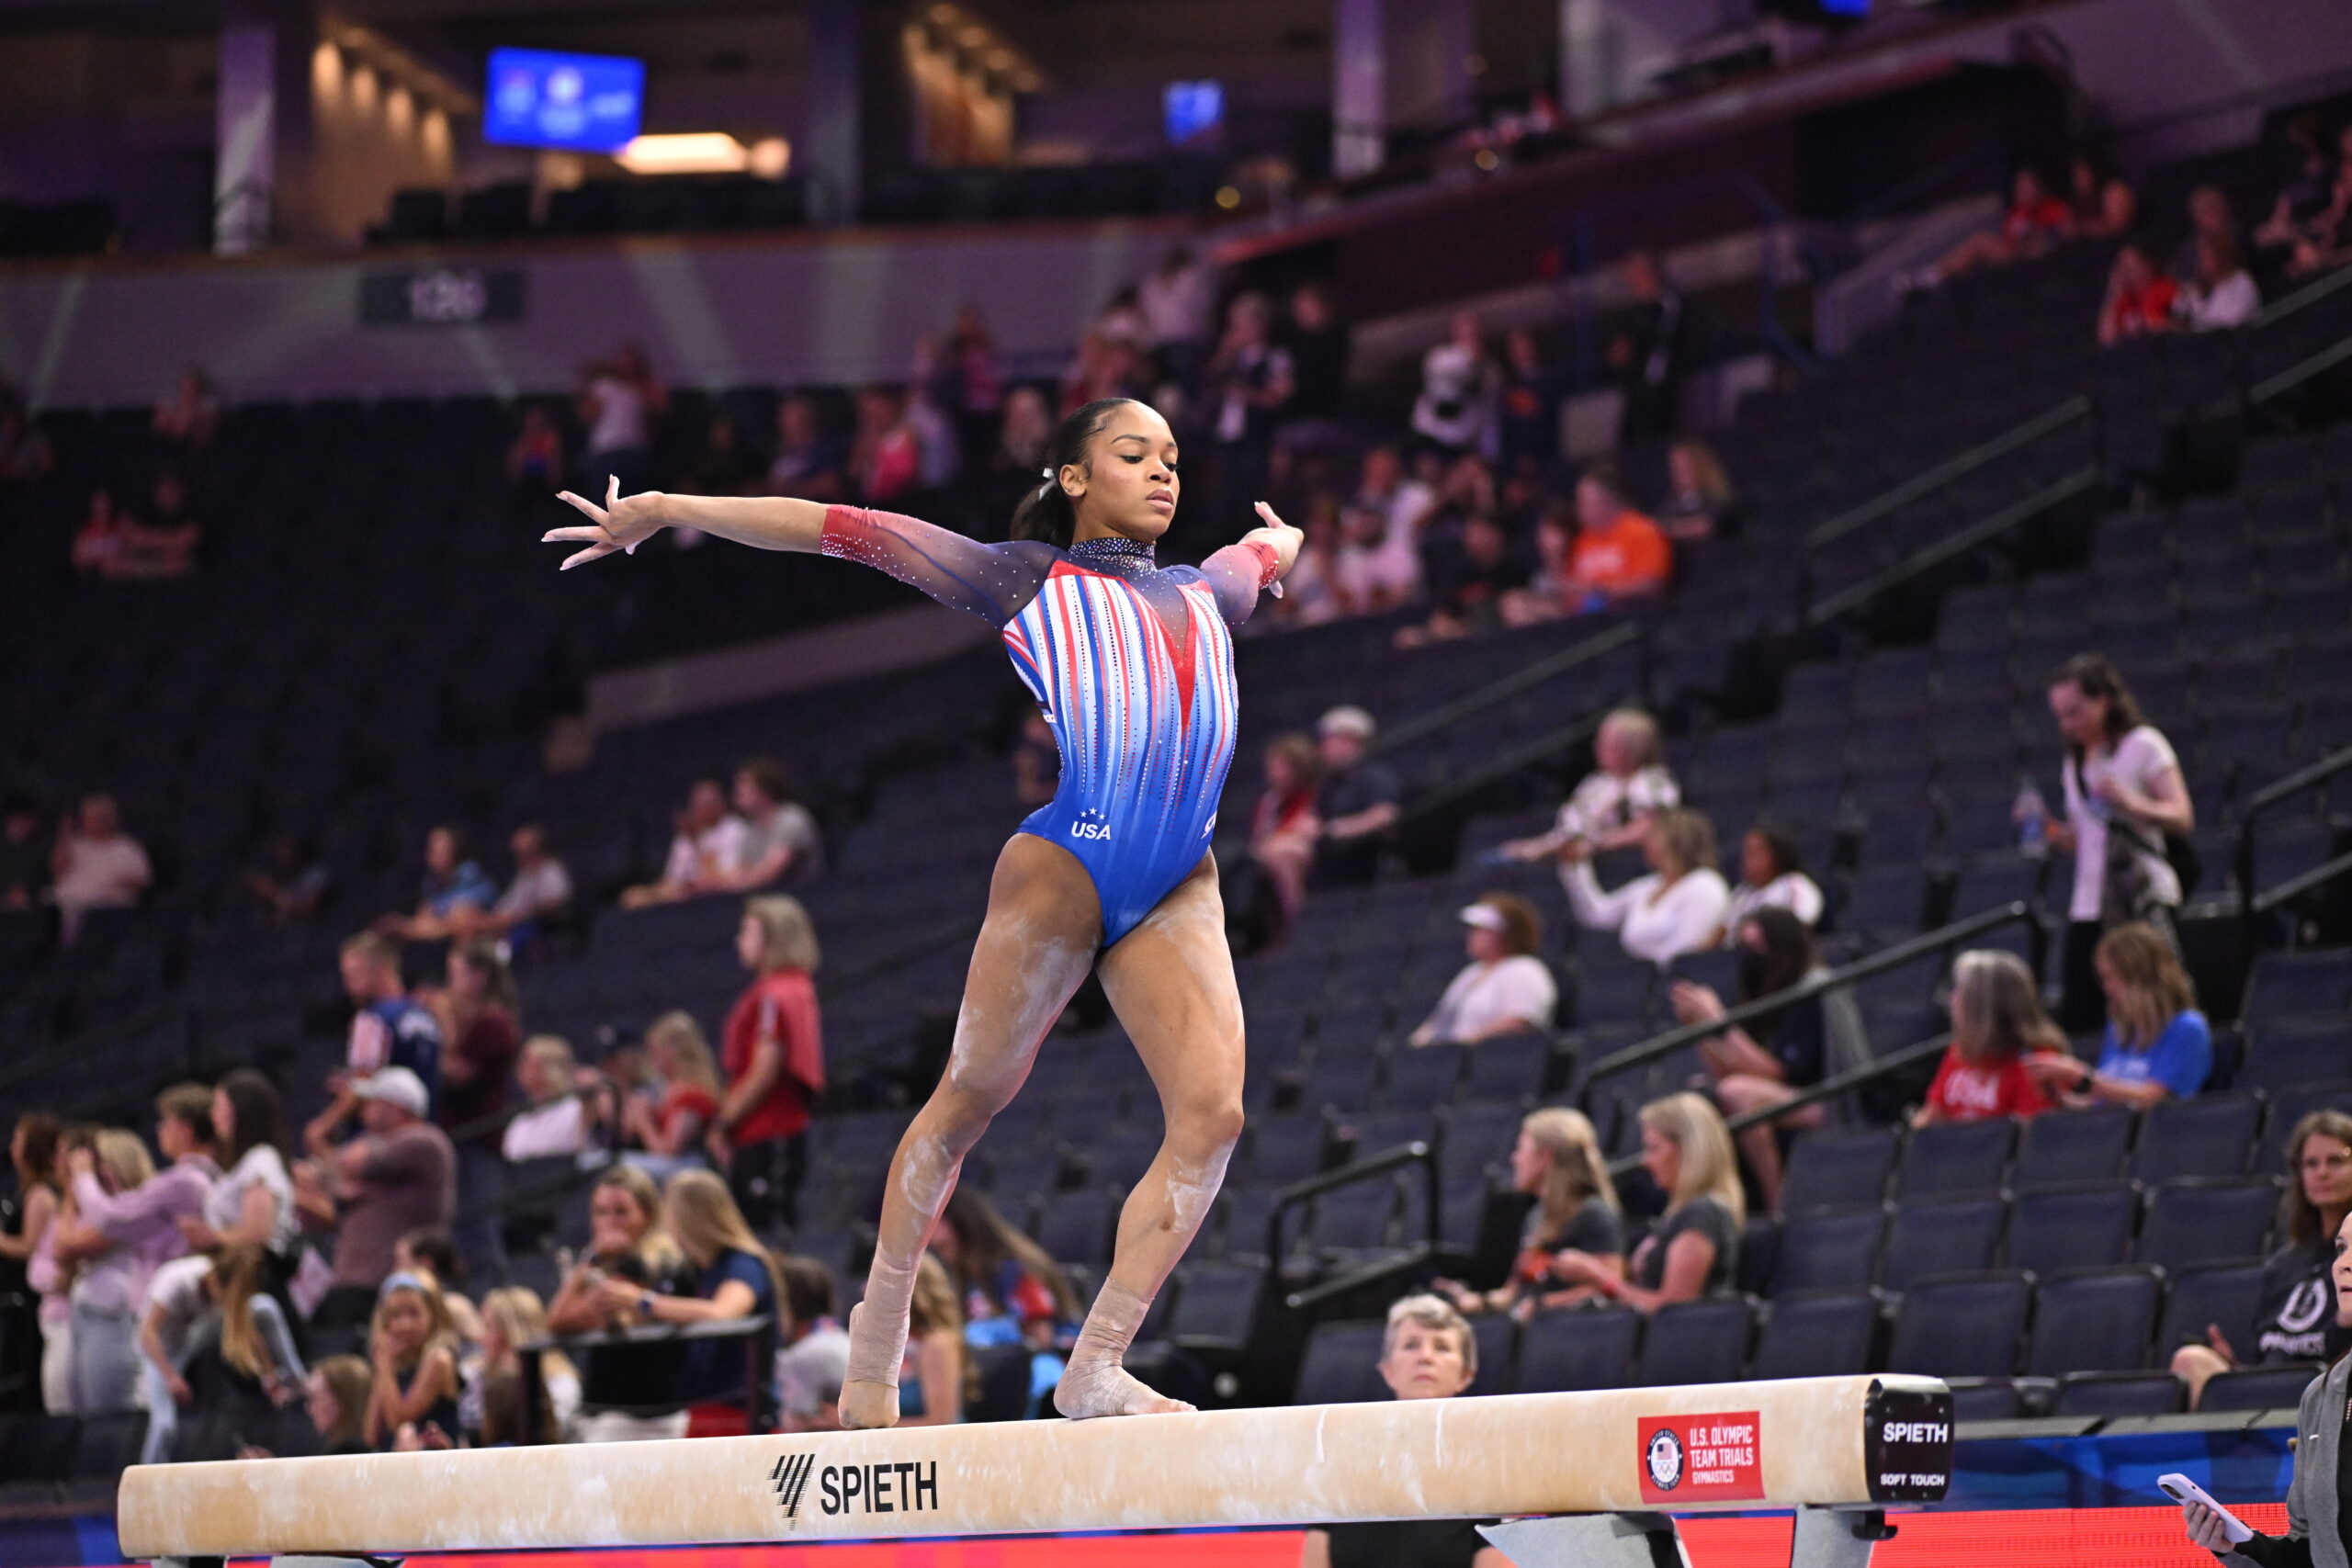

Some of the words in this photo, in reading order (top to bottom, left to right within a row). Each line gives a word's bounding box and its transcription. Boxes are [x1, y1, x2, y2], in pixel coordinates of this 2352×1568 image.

[1071, 820, 1111, 840] USA
[1690, 1427, 1708, 1447] U.S.
[1711, 1425, 1753, 1446] OLYMPIC
[1883, 1422, 1949, 1443] SPIETH
[1690, 1450, 1716, 1468] TEAM
[1719, 1447, 1753, 1467] TRIALS
[1692, 1470, 1734, 1484] GYMNASTICS
[1880, 1473, 1907, 1485] SOFT
[1910, 1473, 1945, 1486] TOUCH
[820, 1461, 938, 1516] SPIETH
